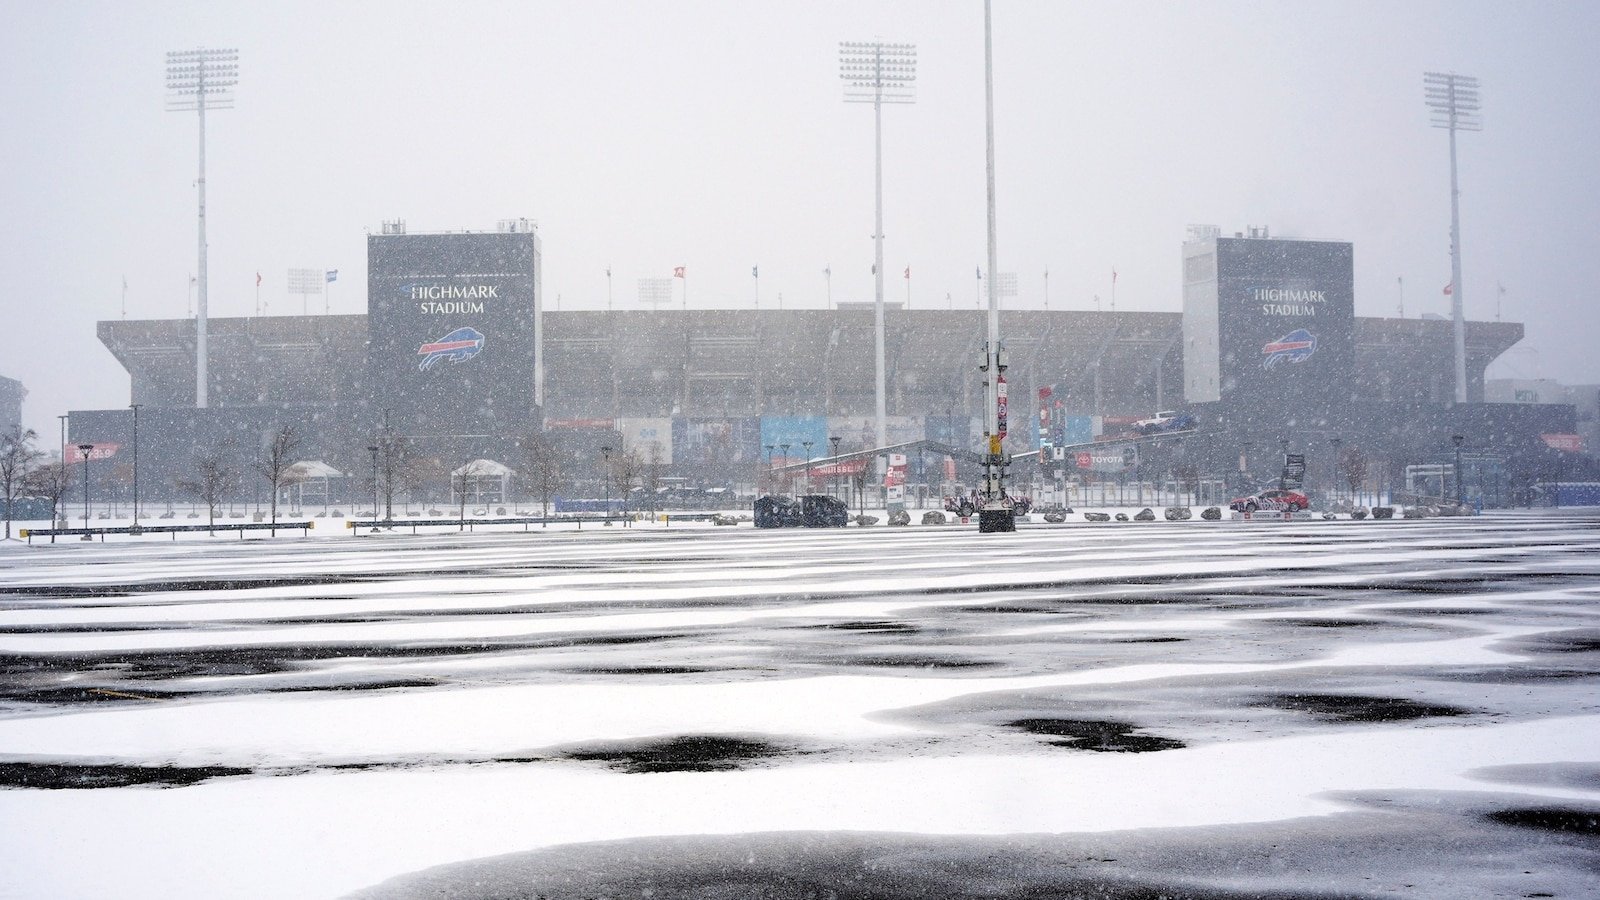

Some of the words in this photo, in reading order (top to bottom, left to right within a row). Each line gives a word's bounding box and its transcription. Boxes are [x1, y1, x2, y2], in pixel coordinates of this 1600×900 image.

[411, 286, 498, 299] HIGHMARK
[1255, 289, 1326, 302] HIGHMARK
[421, 302, 484, 314] STADIUM
[1263, 305, 1315, 316] STADIUM
[1091, 456, 1124, 464] TOYOTA
